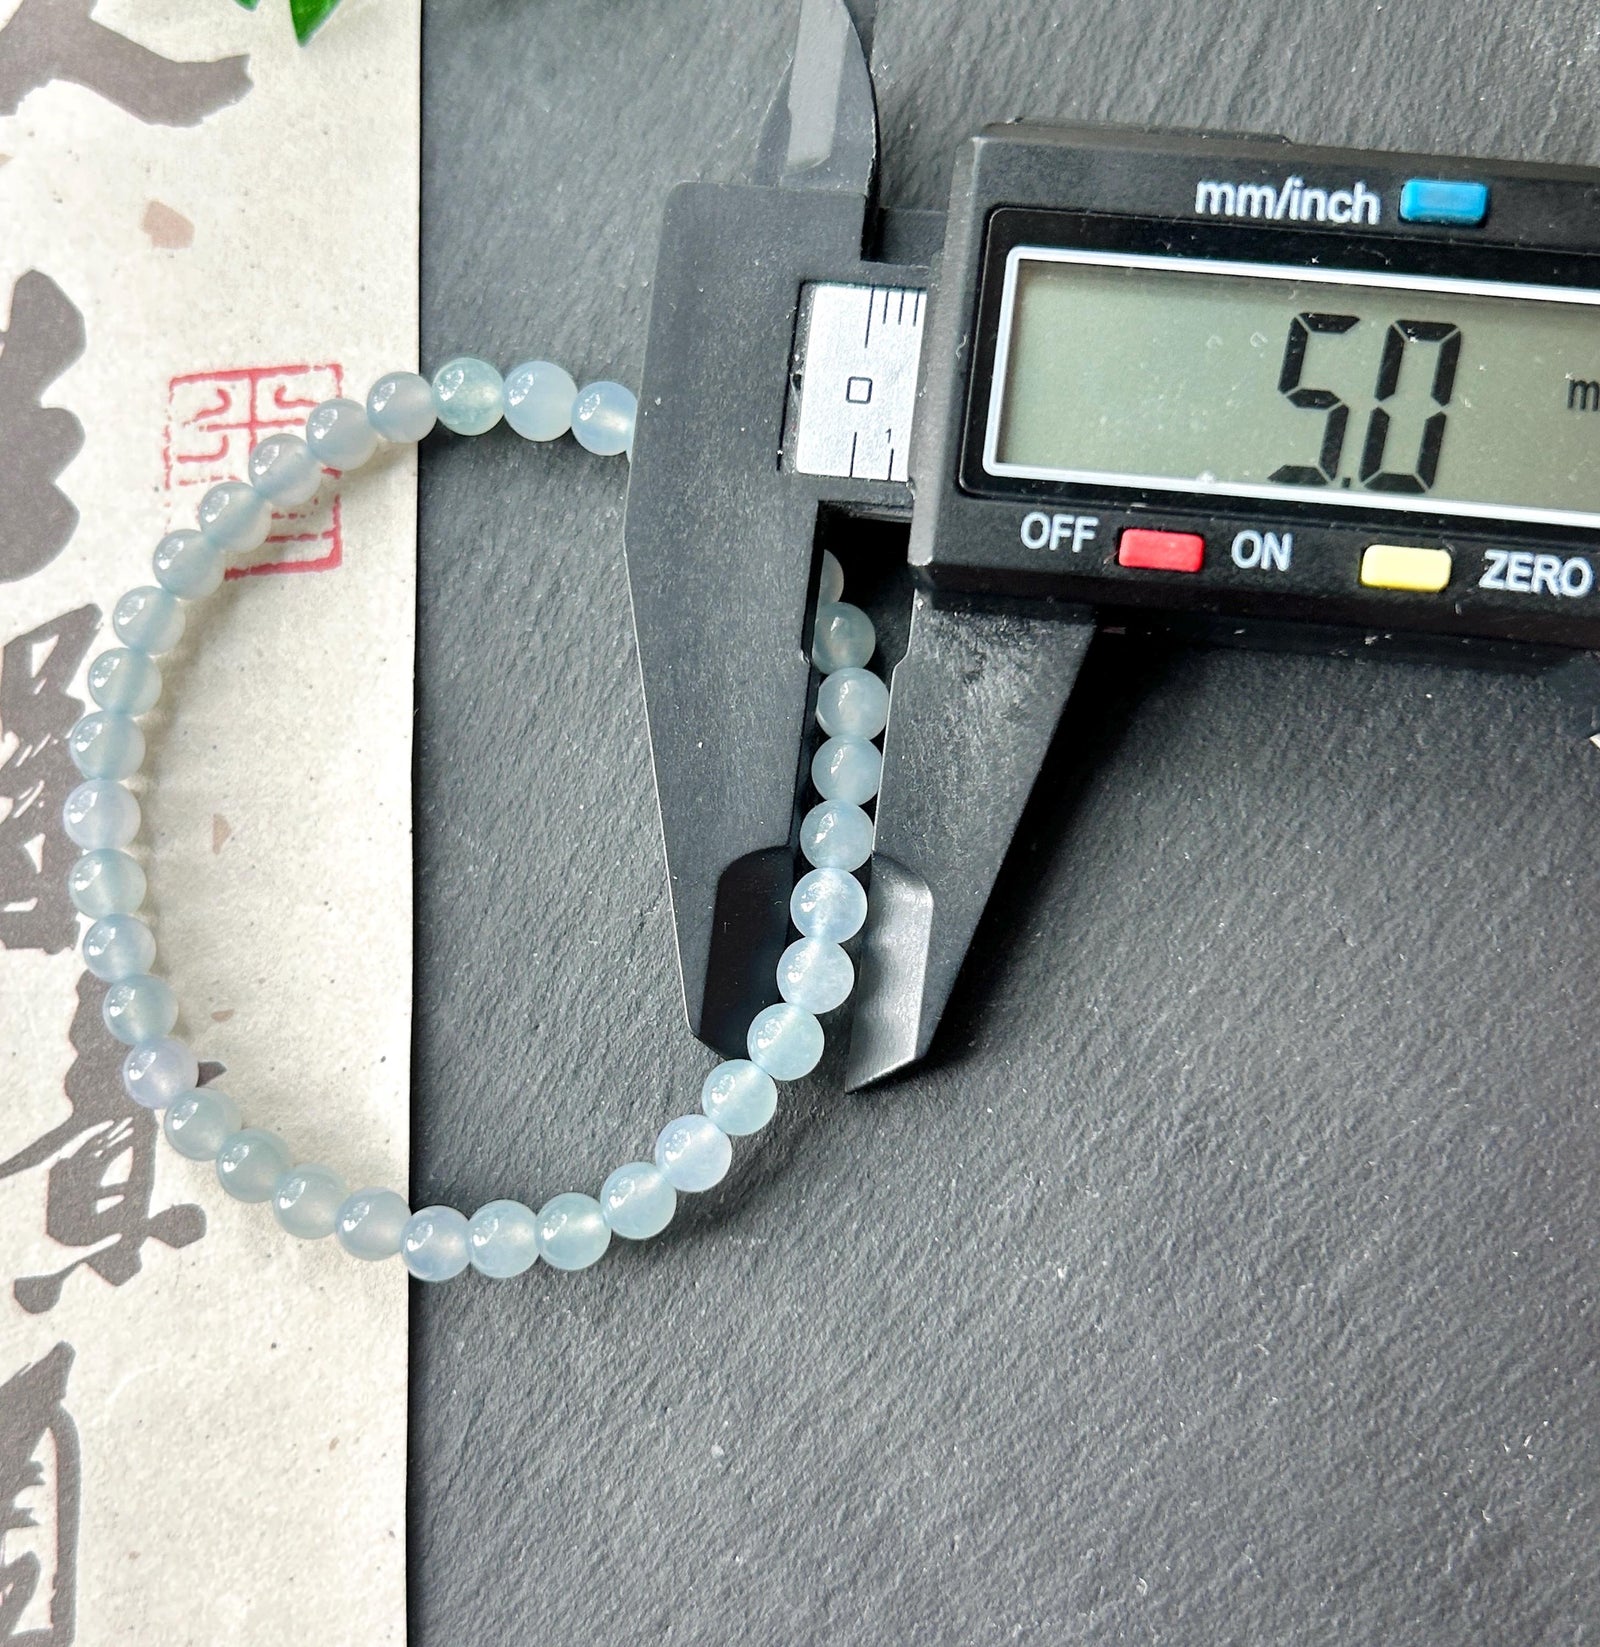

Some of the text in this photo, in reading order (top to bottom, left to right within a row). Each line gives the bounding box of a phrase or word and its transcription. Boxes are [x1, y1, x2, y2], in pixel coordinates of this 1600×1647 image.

[1194, 175, 1382, 226] mm/inch
[1267, 311, 1463, 495] 5.0
[1020, 511, 1593, 598] OFF ON ZERO
